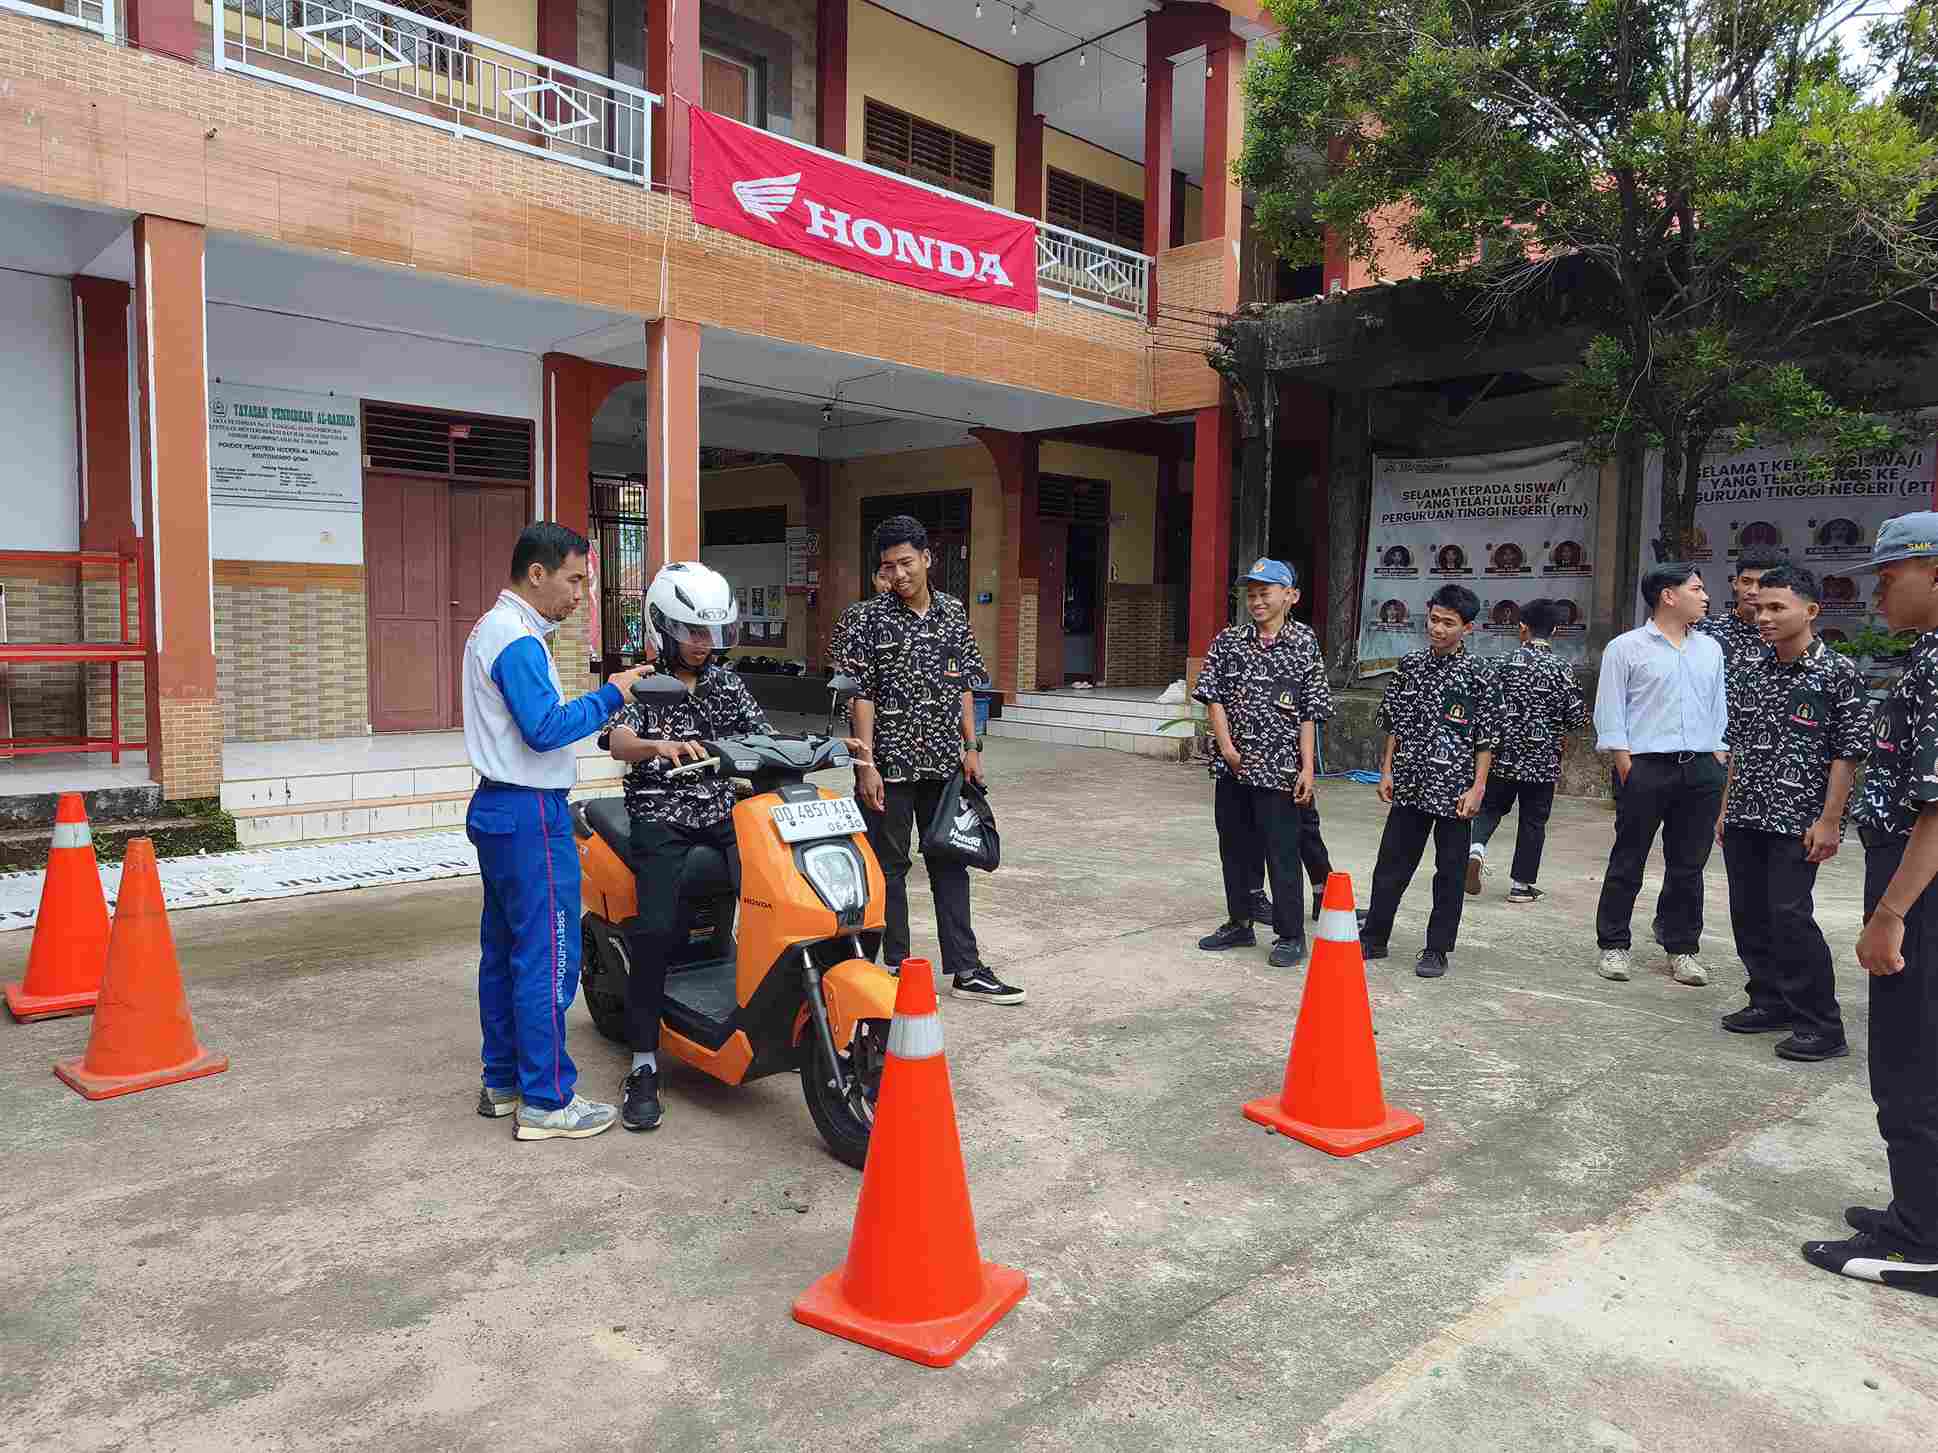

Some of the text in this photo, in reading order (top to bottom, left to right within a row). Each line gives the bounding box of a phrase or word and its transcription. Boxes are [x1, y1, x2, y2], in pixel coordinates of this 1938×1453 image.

[802, 198, 1014, 288] HONDA
[1711, 475, 1757, 490] YANG
[1876, 467, 1900, 481] KE
[1402, 479, 1567, 502] SELAMAT KEPADA SISWA/I
[1766, 482, 1825, 499] TINGGI
[1832, 480, 1893, 497] NEGERI
[1416, 492, 1549, 511] YANG TELAH LULUS KE
[1382, 502, 1589, 525] PERGURUAN TINGGI NEGERI (PTN)
[799, 801, 829, 820] 4857
[743, 896, 774, 912] HONDA
